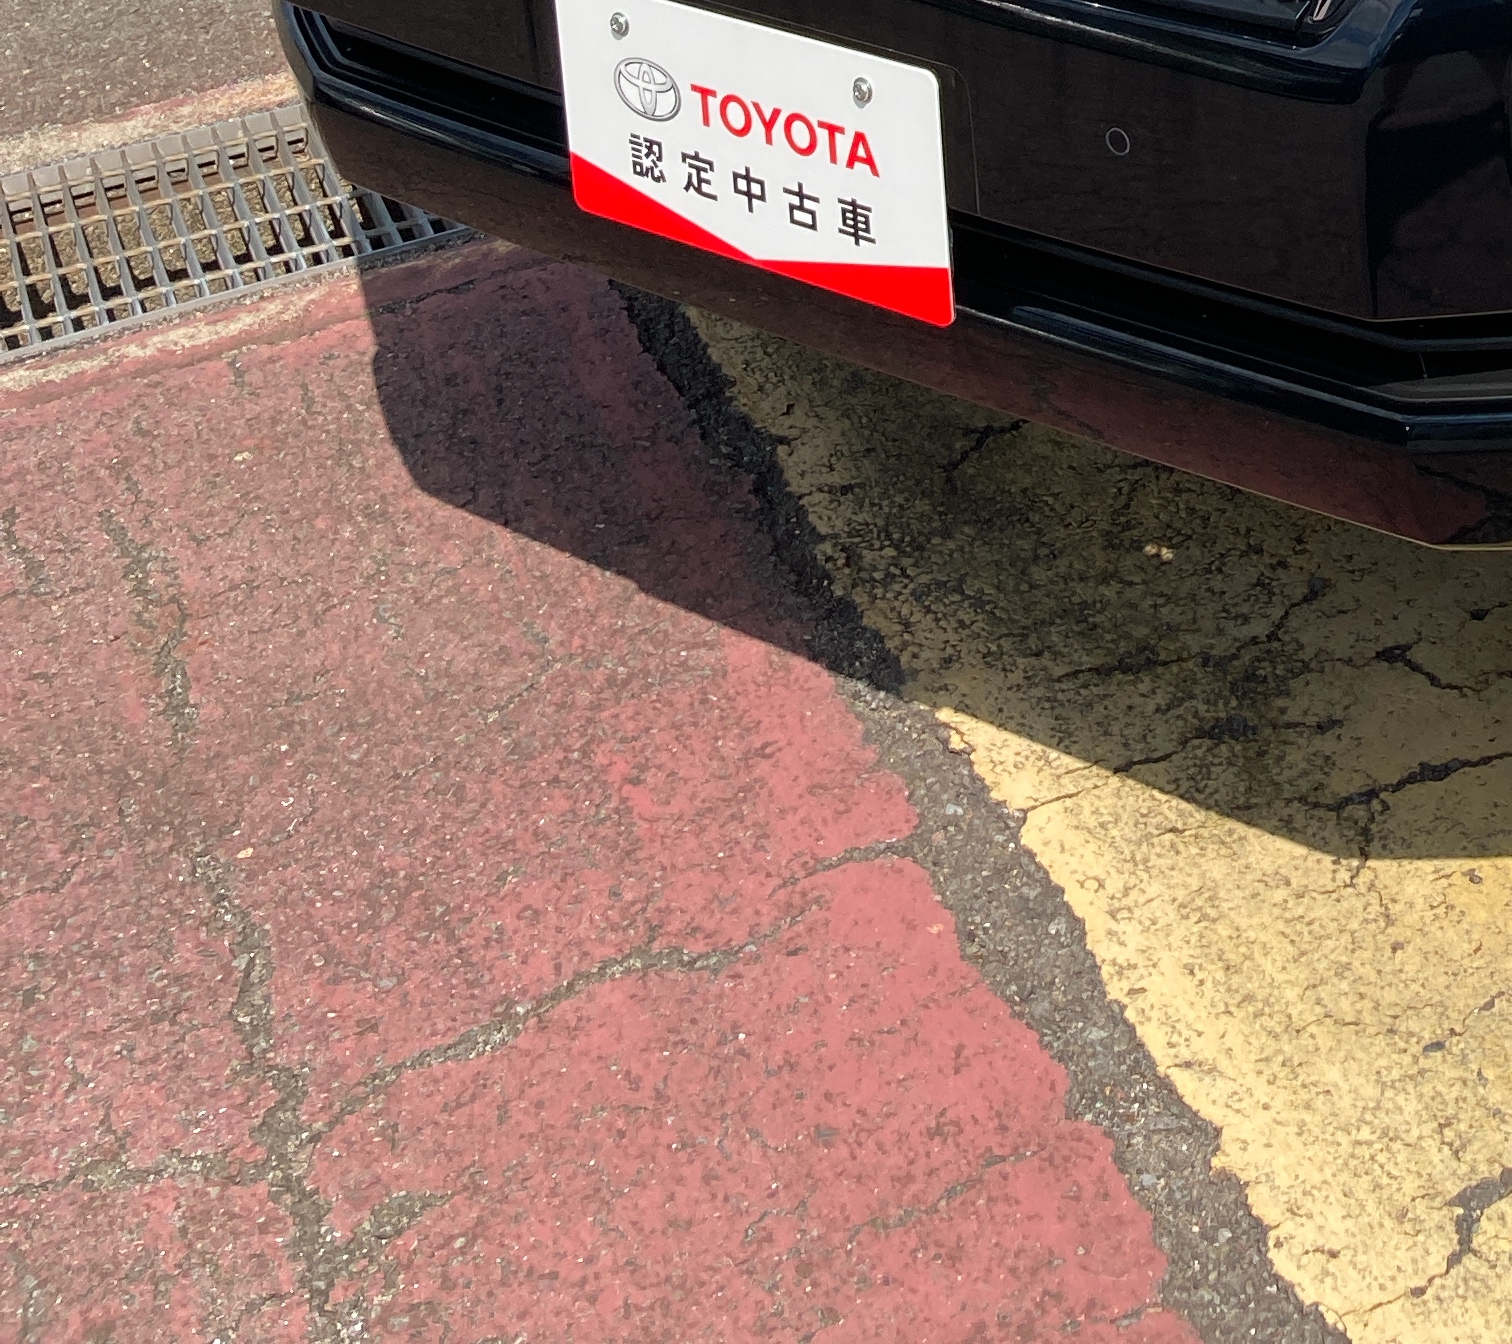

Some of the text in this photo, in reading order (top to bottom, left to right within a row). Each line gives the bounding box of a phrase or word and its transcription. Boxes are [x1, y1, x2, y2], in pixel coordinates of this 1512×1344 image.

[690, 83, 880, 178] TOYOTA
[628, 132, 877, 247] 認定中古車
